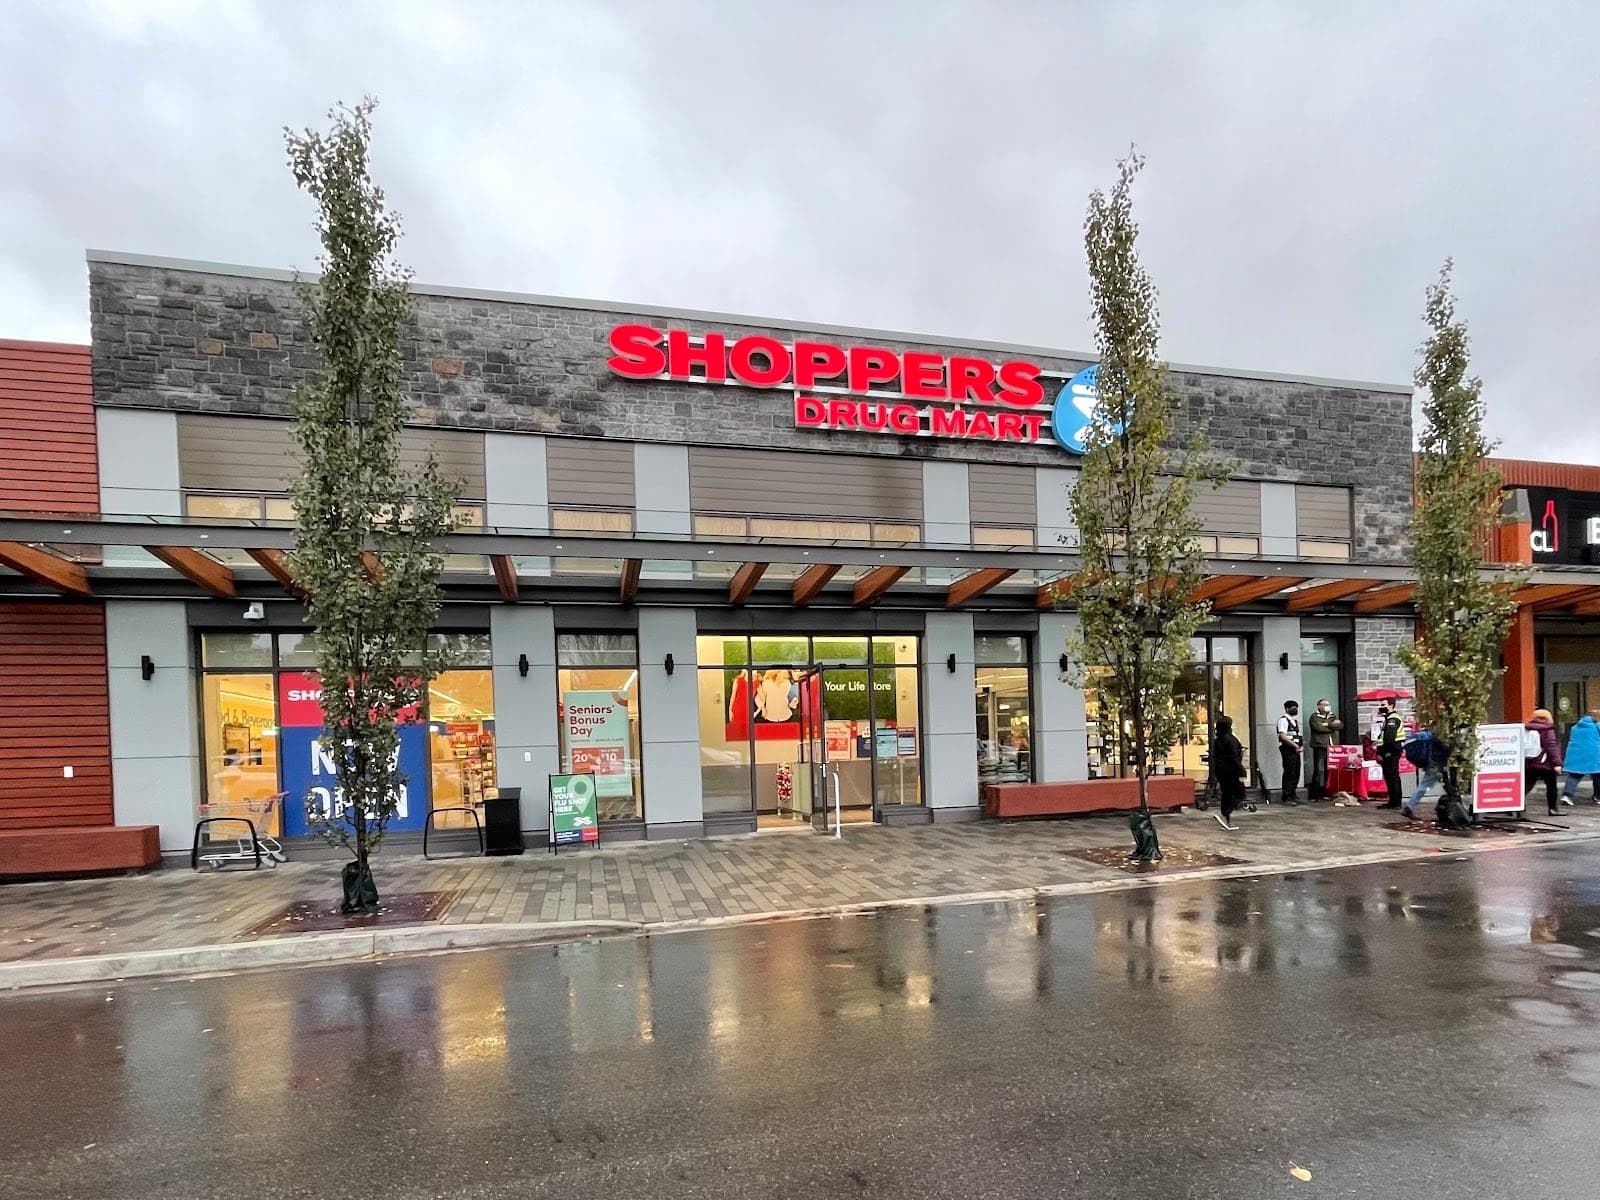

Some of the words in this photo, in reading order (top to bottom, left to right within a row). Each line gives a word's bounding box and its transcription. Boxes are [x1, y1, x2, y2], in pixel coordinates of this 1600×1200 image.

[606, 323, 1046, 408] SHOPPERS
[796, 397, 920, 437] DRUG
[931, 406, 1046, 443] MART
[824, 681, 846, 691] Your
[848, 680, 866, 691] Life
[871, 681, 891, 690] tore
[569, 705, 614, 715] Seniors'
[570, 716, 605, 725] Bonus
[570, 727, 592, 737] Day
[553, 786, 567, 794] GET
[553, 792, 574, 800] YOUR
